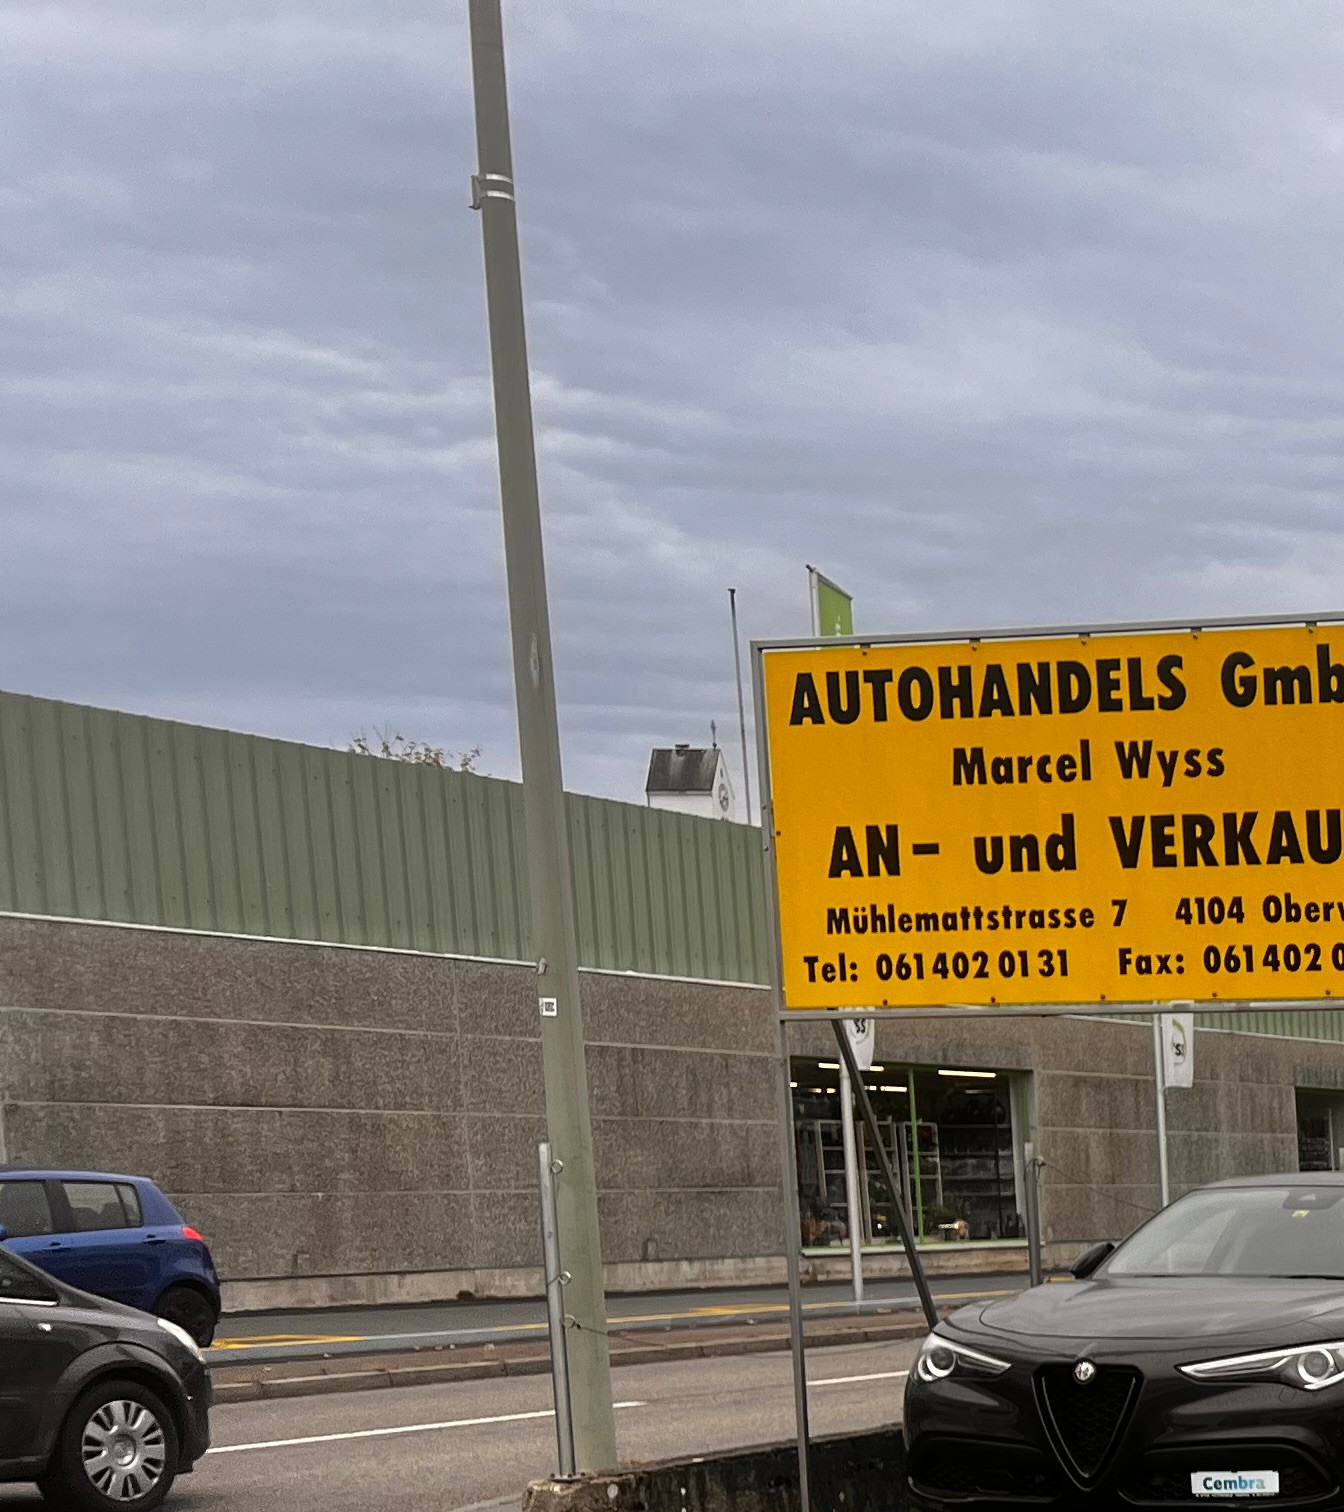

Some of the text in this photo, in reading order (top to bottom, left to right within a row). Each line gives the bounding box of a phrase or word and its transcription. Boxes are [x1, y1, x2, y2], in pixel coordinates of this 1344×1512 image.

[789, 654, 1187, 726] AUTOHANDELS
[953, 739, 1225, 788] Marcel Wyss
[973, 813, 1077, 875] und
[827, 903, 1095, 935] Mühlemattstrasse
[1111, 899, 1128, 926] 7
[1175, 896, 1245, 925] 4104
[803, 952, 858, 983] Tel:
[1118, 947, 1185, 975] Fax:
[1202, 1475, 1266, 1491] Cembra
